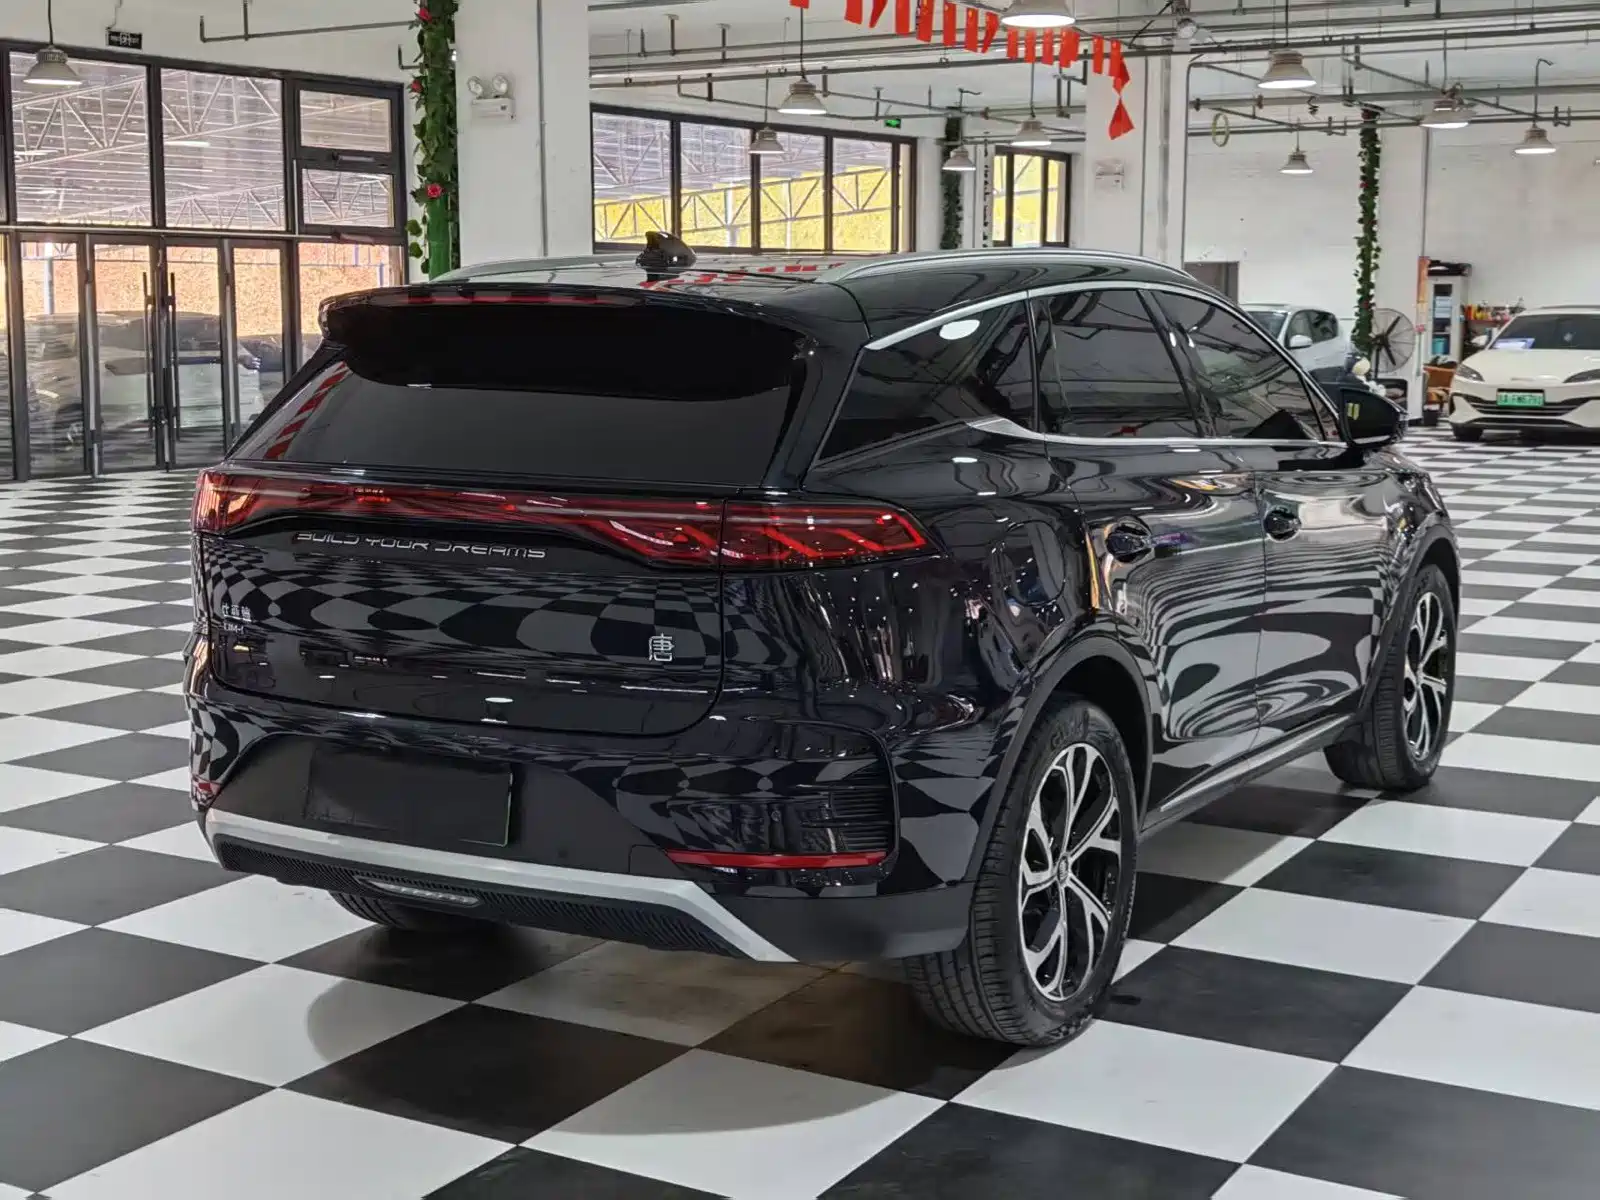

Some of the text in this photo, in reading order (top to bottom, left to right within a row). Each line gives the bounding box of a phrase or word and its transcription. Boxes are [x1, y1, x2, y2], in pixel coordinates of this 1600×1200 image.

[296, 533, 546, 559] BUILD YOUR DREAMS
[648, 632, 675, 662] 唐
